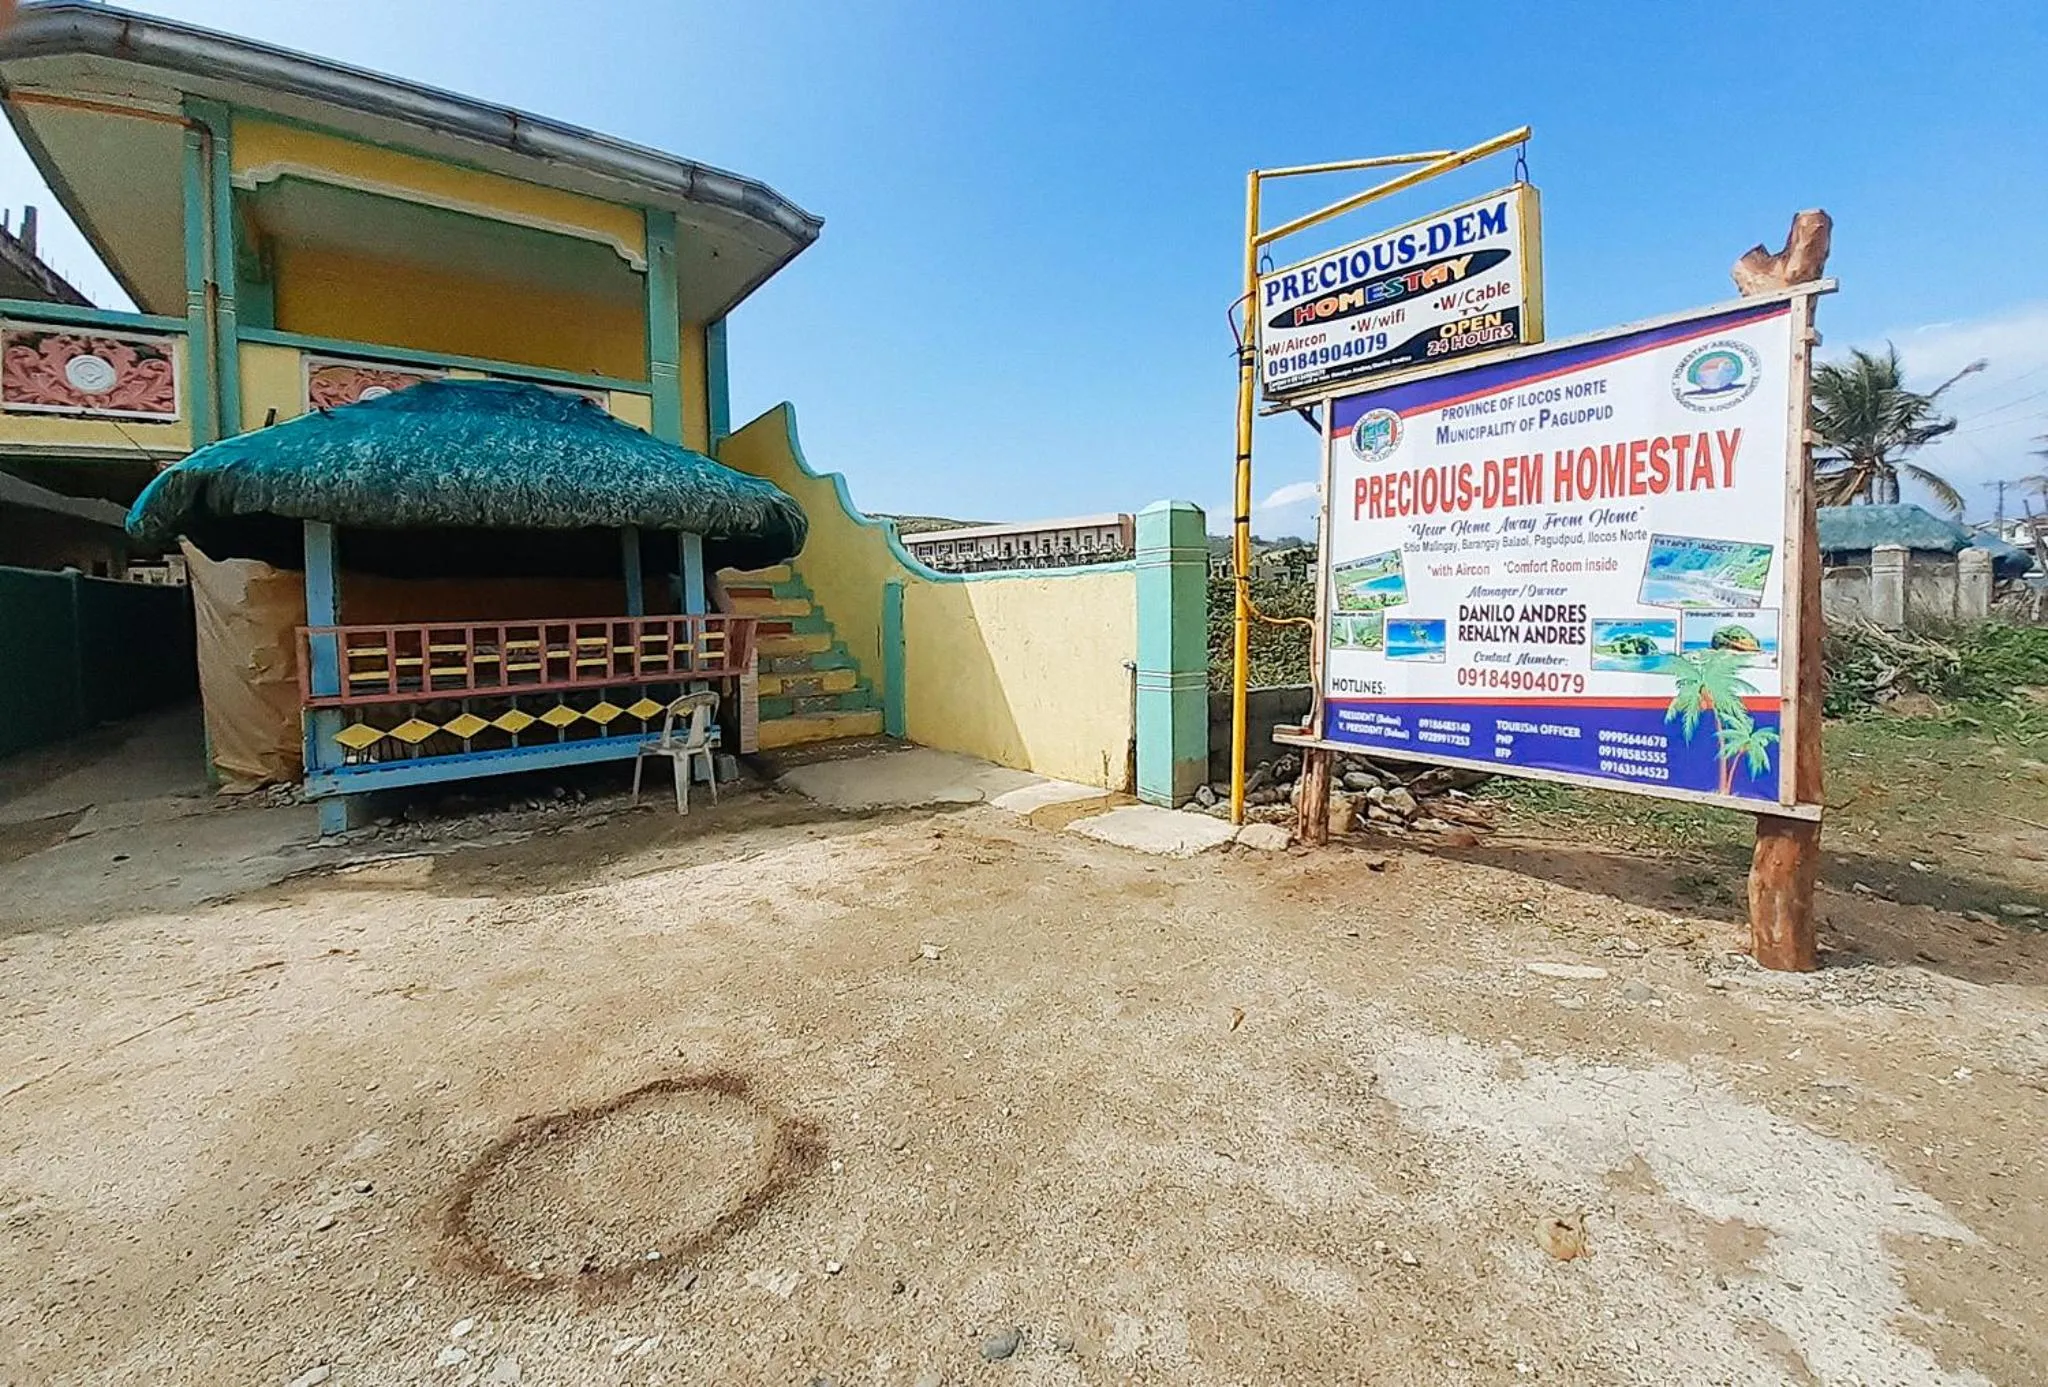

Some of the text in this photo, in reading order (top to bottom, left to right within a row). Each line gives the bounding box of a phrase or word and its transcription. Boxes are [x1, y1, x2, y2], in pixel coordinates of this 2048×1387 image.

[1265, 202, 1508, 306] PRECIOUS-DEM
[1293, 253, 1475, 326] HOMESTAY
[1440, 312, 1502, 338] OPEN
[1427, 322, 1514, 356] 24 HOURS
[1268, 332, 1388, 377] 09184904079
[1441, 379, 1607, 421] PROVINCE OF ILOCOS NORTE
[1436, 405, 1613, 445] MUNICIPALITY OF PAGUDPUD
[1354, 428, 1742, 521] PRECIOUS-DEM HOMESTAY
[1451, 520, 1491, 536] Home
[1496, 516, 1537, 534] Away
[1543, 512, 1583, 530] From
[1534, 533, 1585, 548] Pagudpud,
[1587, 531, 1617, 543] Ilocos
[1620, 529, 1647, 540] Norte
[1456, 563, 1490, 576] Aircon
[1550, 558, 1581, 572] Room
[1460, 604, 1586, 623] DANILO ANDRES
[1459, 625, 1586, 645] RENALYN ANDRES
[1474, 651, 1512, 663] Contact
[1332, 678, 1386, 695] HOTLINES:
[1458, 667, 1584, 693] 09184904079
[1496, 720, 1581, 738] TOURISM OFFICER
[1496, 734, 1514, 745] PNP
